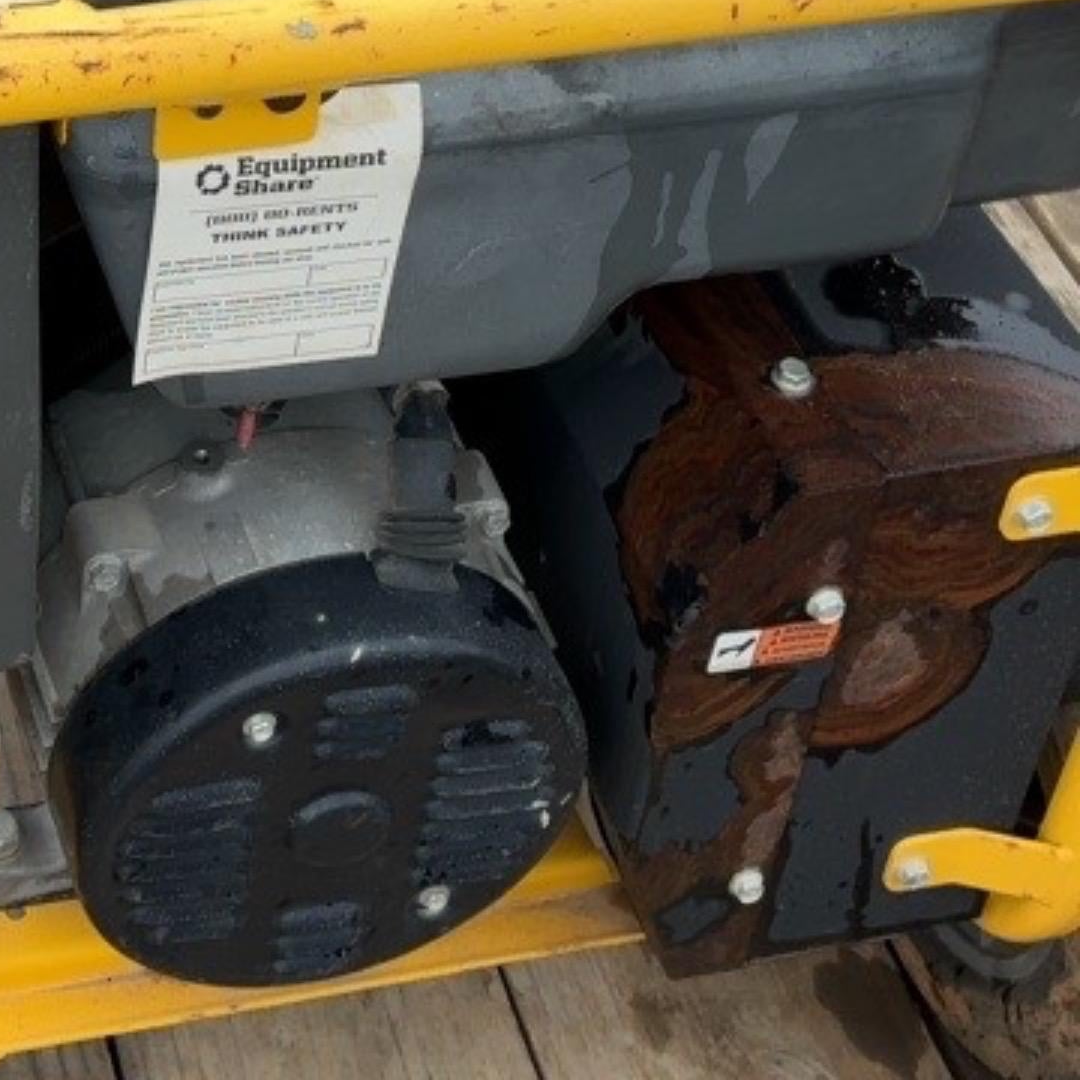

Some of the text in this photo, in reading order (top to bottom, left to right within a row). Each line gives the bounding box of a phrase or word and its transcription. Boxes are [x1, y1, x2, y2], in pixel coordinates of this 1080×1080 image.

[236, 149, 388, 178] Equipment
[212, 221, 348, 244] THINK SAFETY
